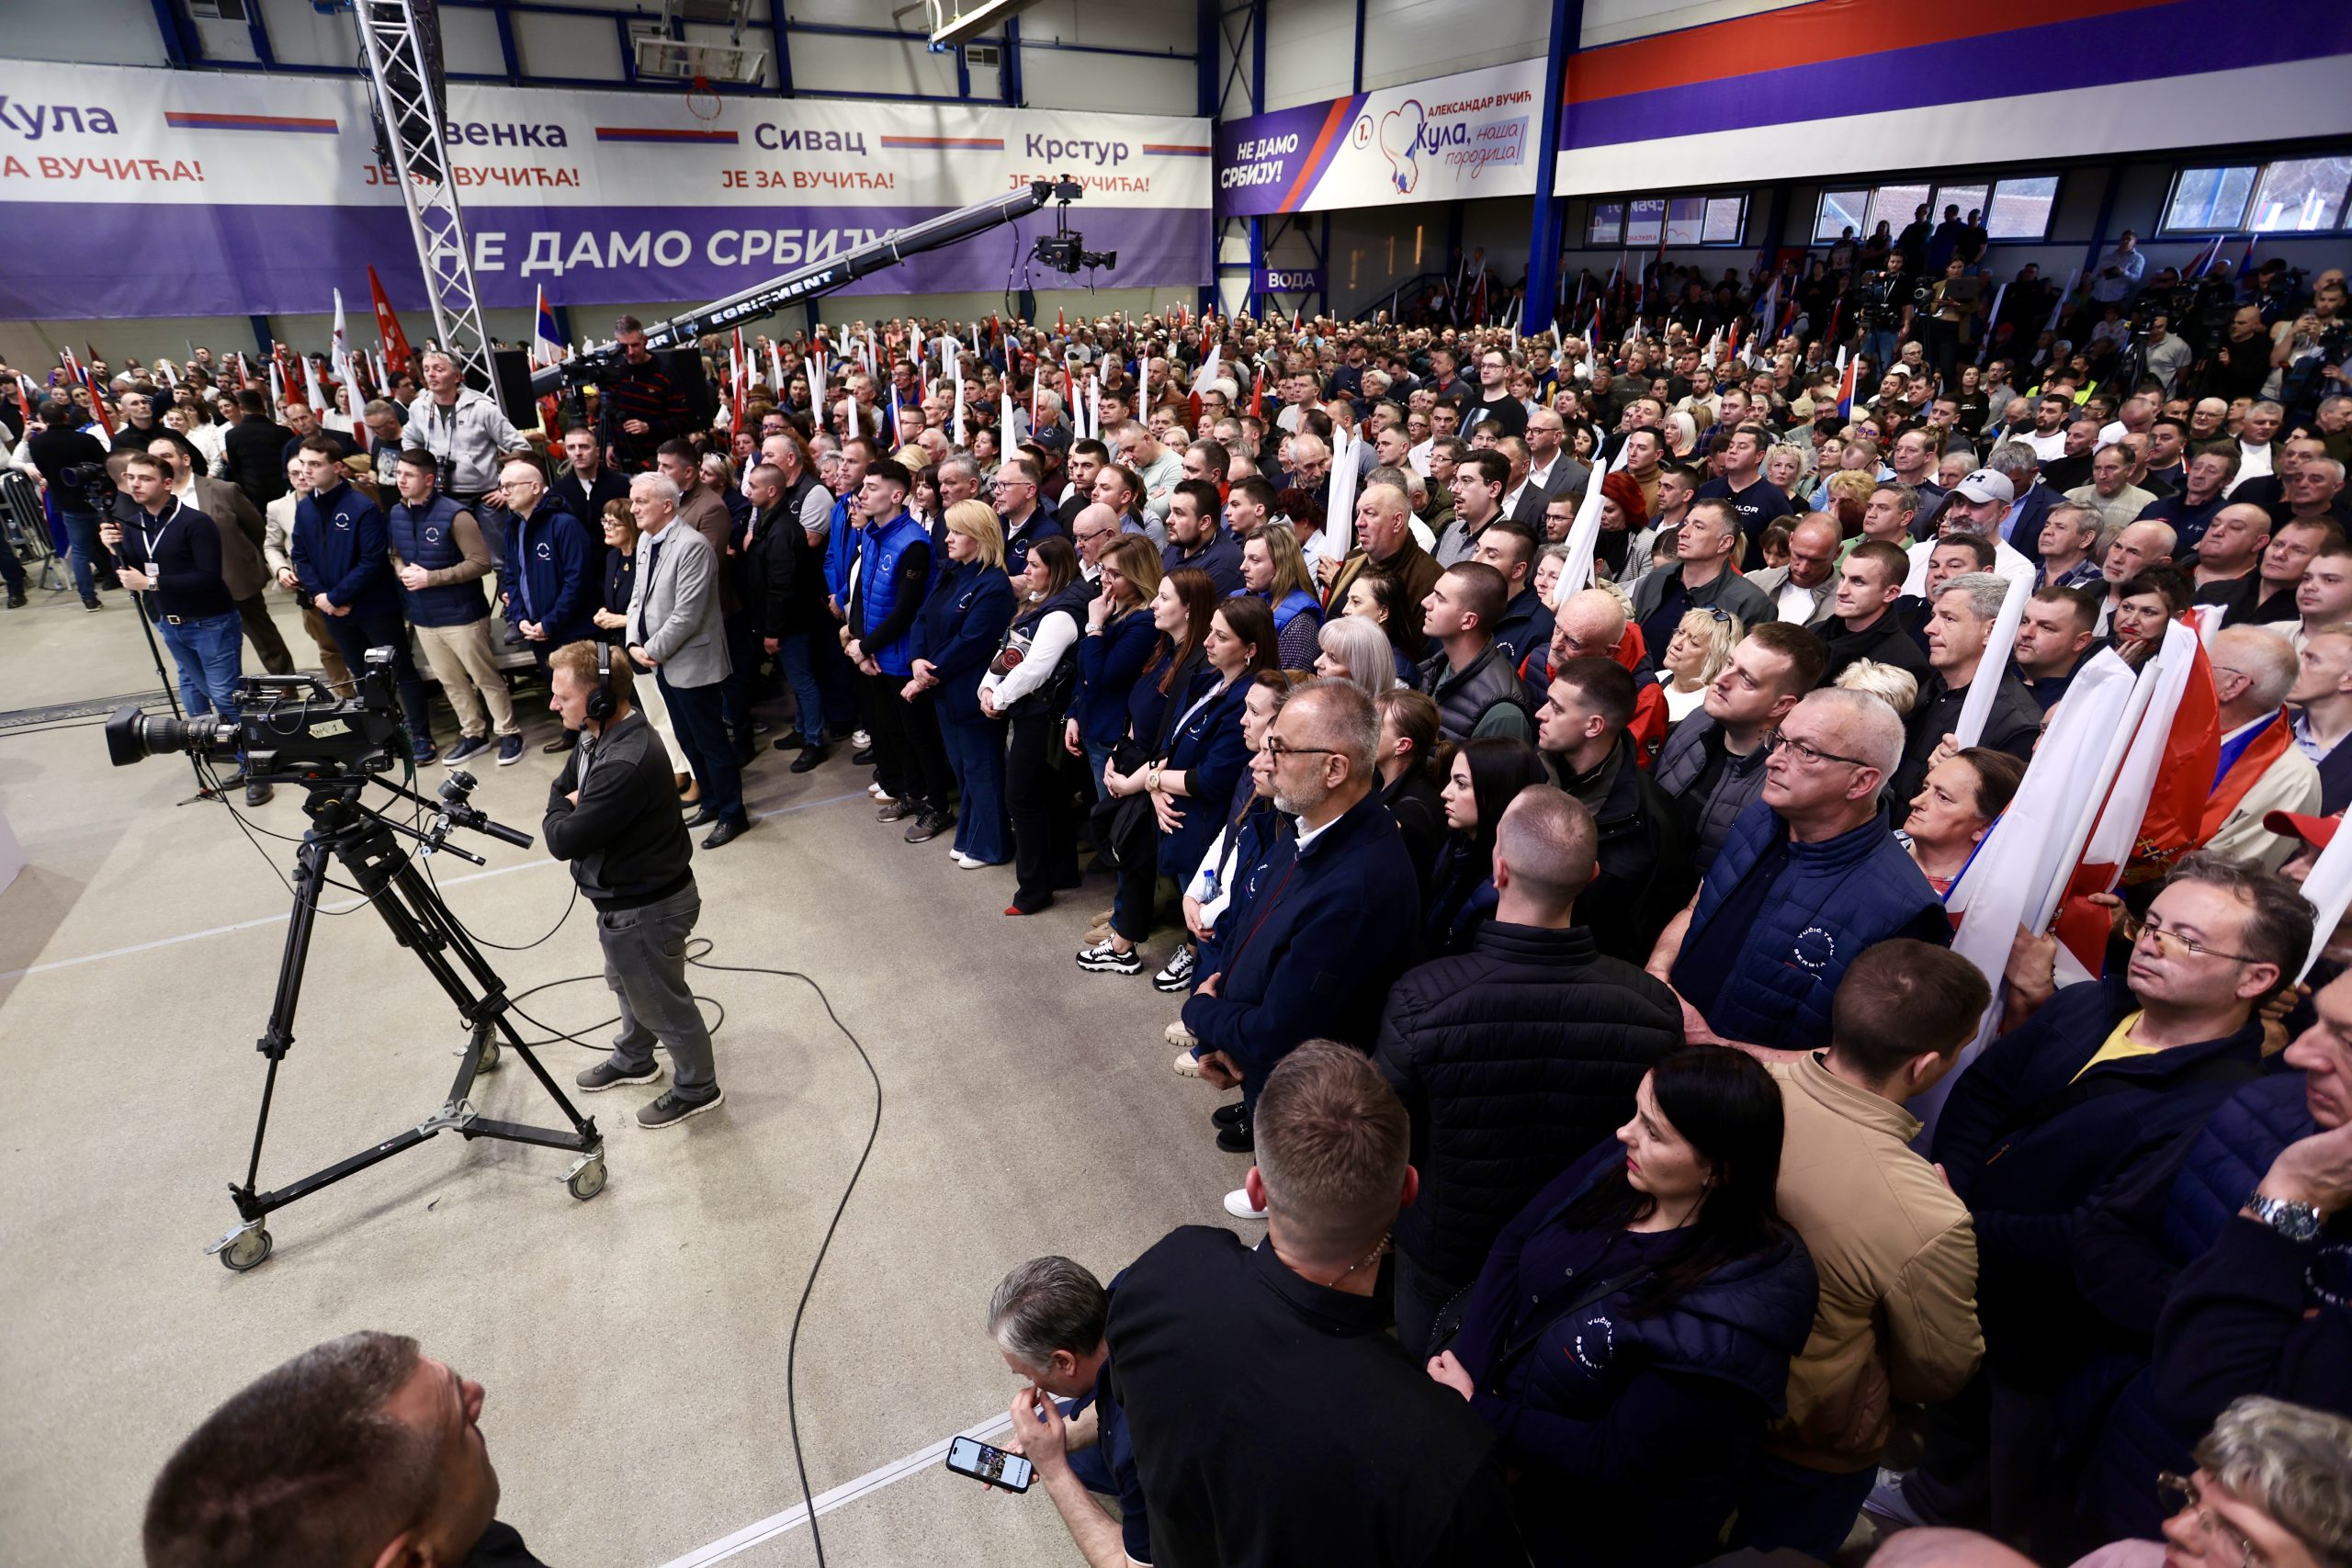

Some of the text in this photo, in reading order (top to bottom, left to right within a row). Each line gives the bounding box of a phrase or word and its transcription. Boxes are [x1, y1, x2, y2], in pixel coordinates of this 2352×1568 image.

[1428, 91, 1532, 118] АЛЕКСАНДАР ВУЧИЋ
[446, 121, 568, 148] венка
[755, 122, 866, 156] Сивац
[1360, 124, 1368, 141] 1.
[1416, 122, 1518, 155] Кула, наша
[1025, 133, 1129, 166] Крстур
[1237, 133, 1299, 161] НЕ ДАМО
[4, 155, 205, 182] А ВУЧИЋА!
[453, 166, 580, 187] ВУЧИЋА!
[722, 171, 894, 189] ЈЕ ЗА ВУЧИЋА!
[1221, 160, 1283, 189] СРБИЈУ!
[520, 230, 692, 277] ДАМО
[706, 229, 906, 266] СРБИЈ
[1268, 272, 1316, 289] ВОДА
